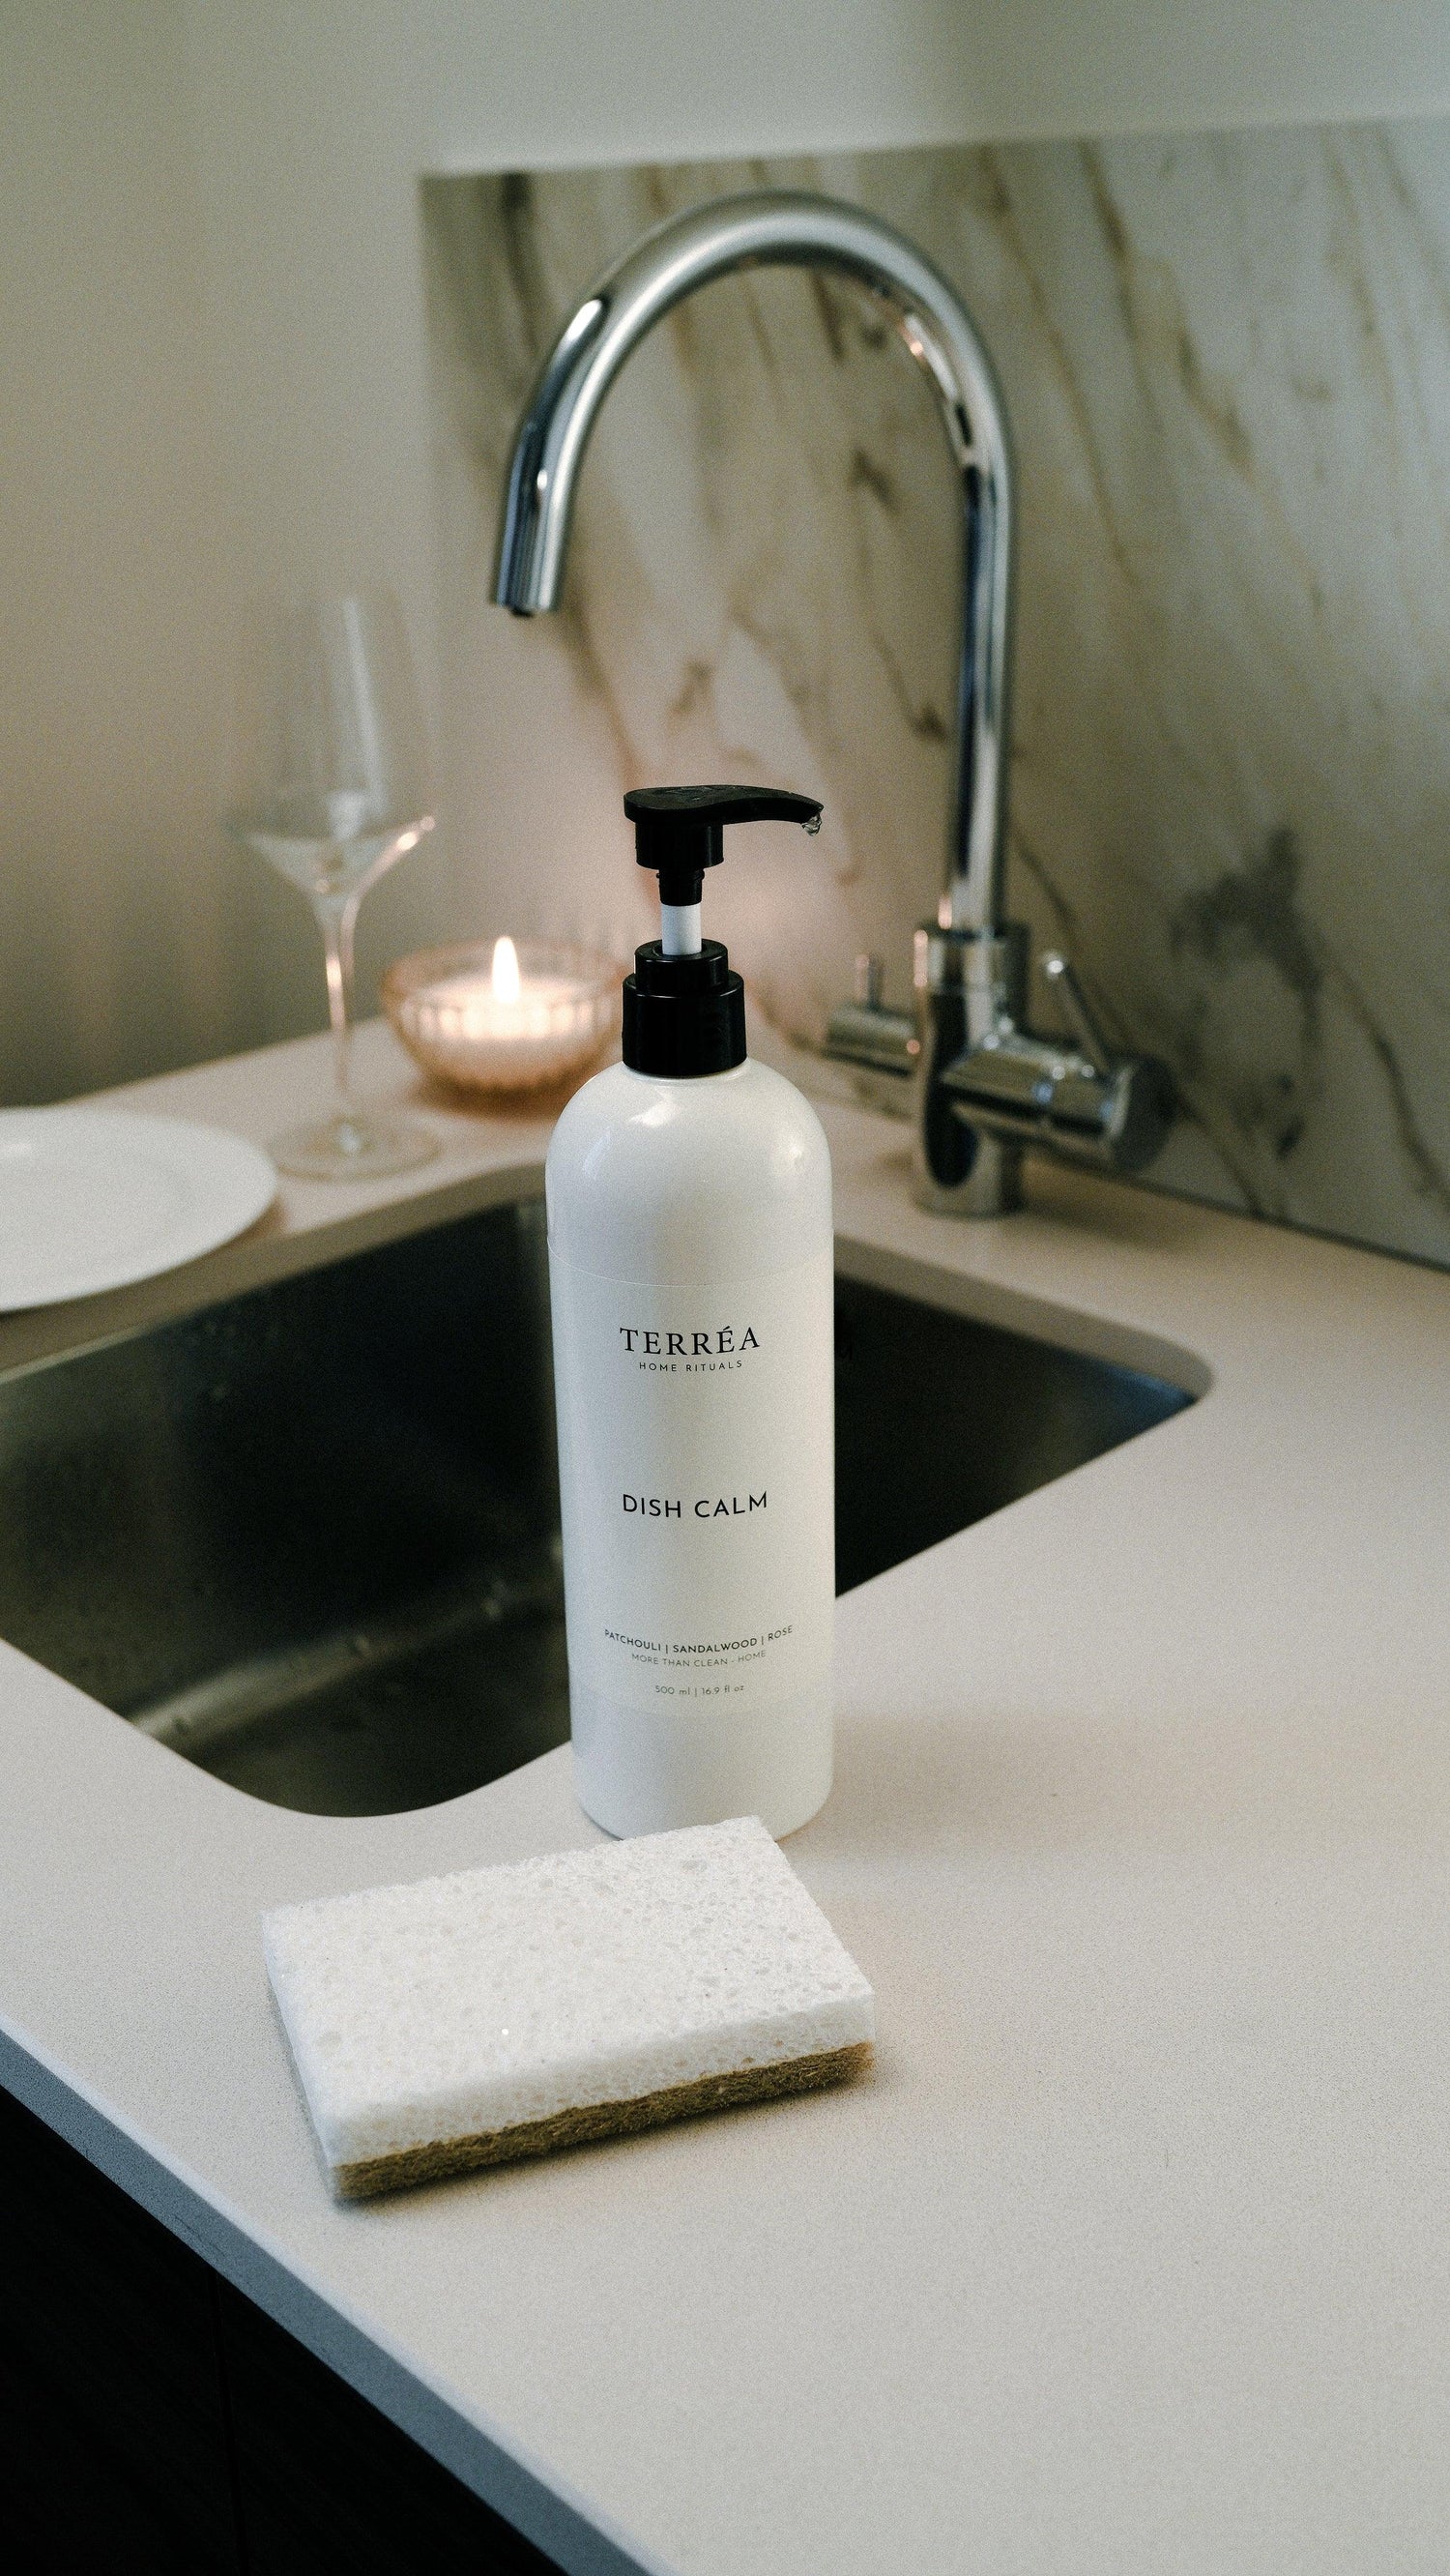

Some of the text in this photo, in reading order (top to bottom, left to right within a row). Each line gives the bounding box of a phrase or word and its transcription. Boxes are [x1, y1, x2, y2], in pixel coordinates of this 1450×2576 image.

[620, 1326, 760, 1356] TERRÉA
[639, 1360, 743, 1372] HOME RITUALS
[623, 1490, 768, 1518] DISH CALM
[604, 1628, 661, 1652] PATCHOULI
[673, 1638, 758, 1654] SANDALWOOD
[768, 1625, 794, 1641] ROSE
[631, 1653, 659, 1665] MORE
[662, 1657, 690, 1668] THAN
[693, 1657, 728, 1668] CLEAN
[738, 1650, 767, 1663] HOME
[655, 1684, 675, 1695] 500
[679, 1685, 690, 1695] ml
[701, 1685, 720, 1696] 16.9
